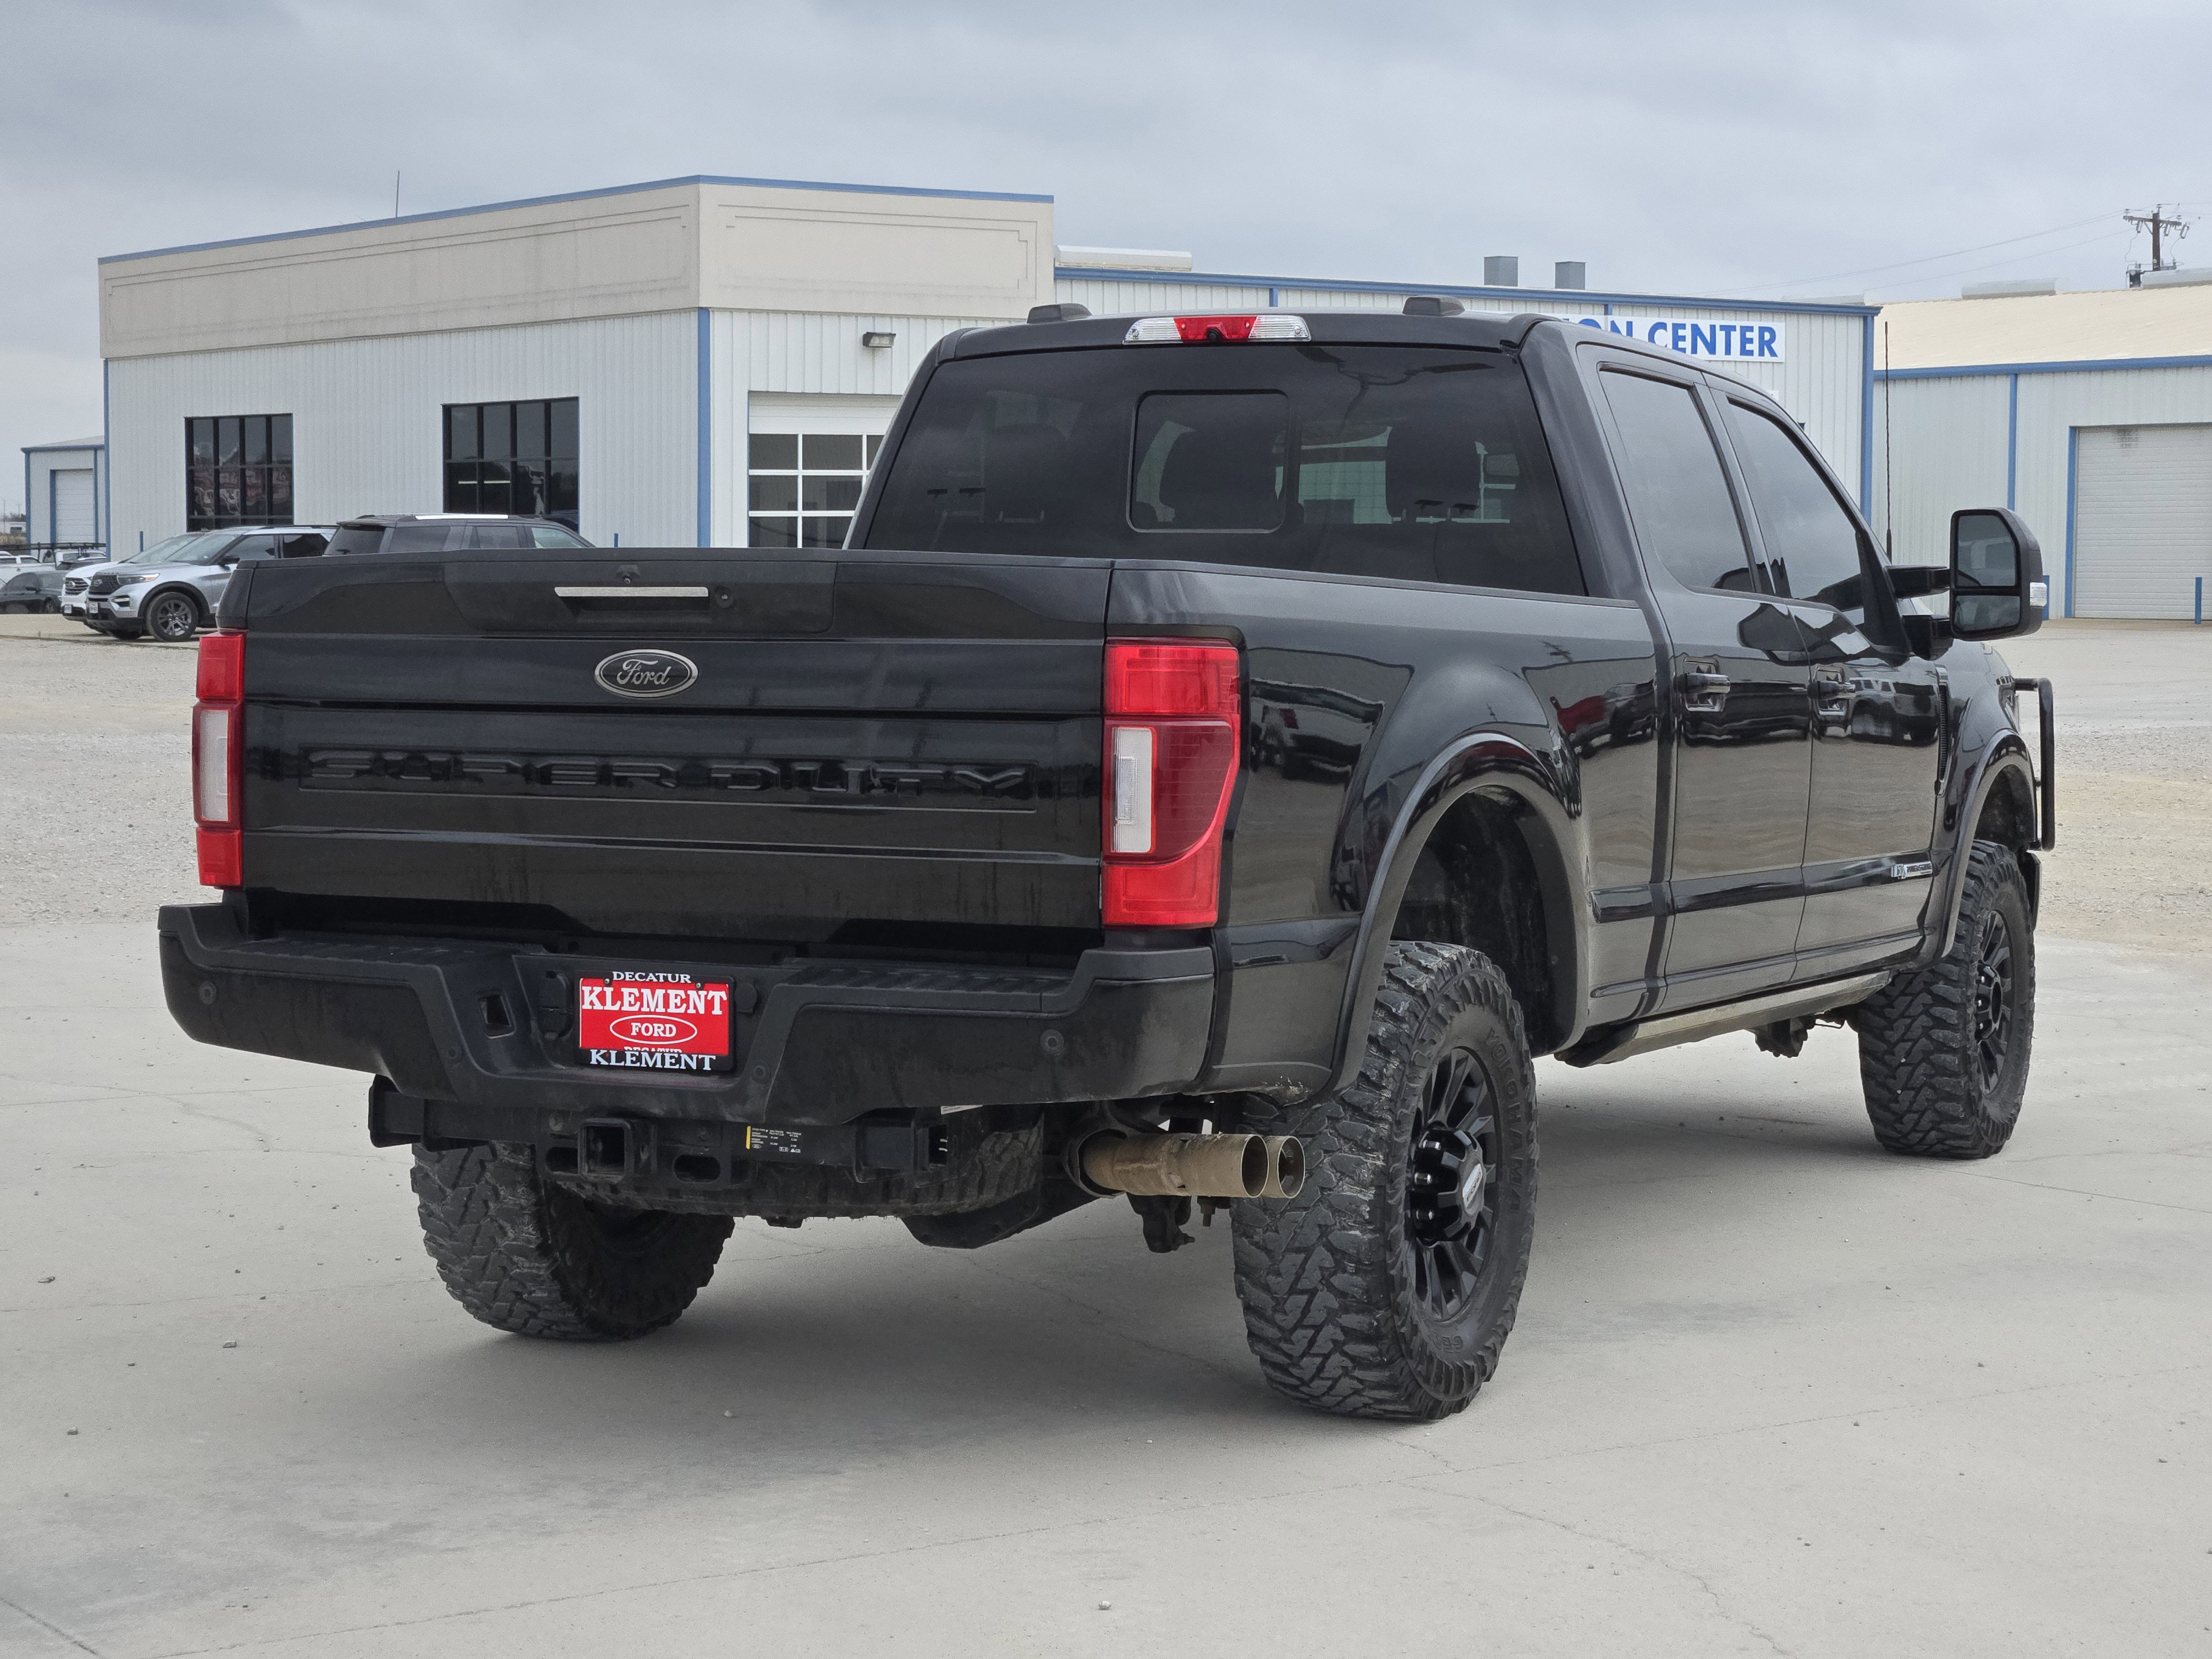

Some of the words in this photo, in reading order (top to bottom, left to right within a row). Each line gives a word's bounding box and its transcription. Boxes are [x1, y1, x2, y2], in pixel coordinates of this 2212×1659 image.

[1647, 321, 1778, 358] CENTER
[616, 659, 672, 685] Ford
[612, 971, 692, 984] DECATUR
[582, 986, 728, 1015] KLEMENT
[630, 1022, 677, 1037] FORD
[589, 1049, 717, 1071] KLEMENT
